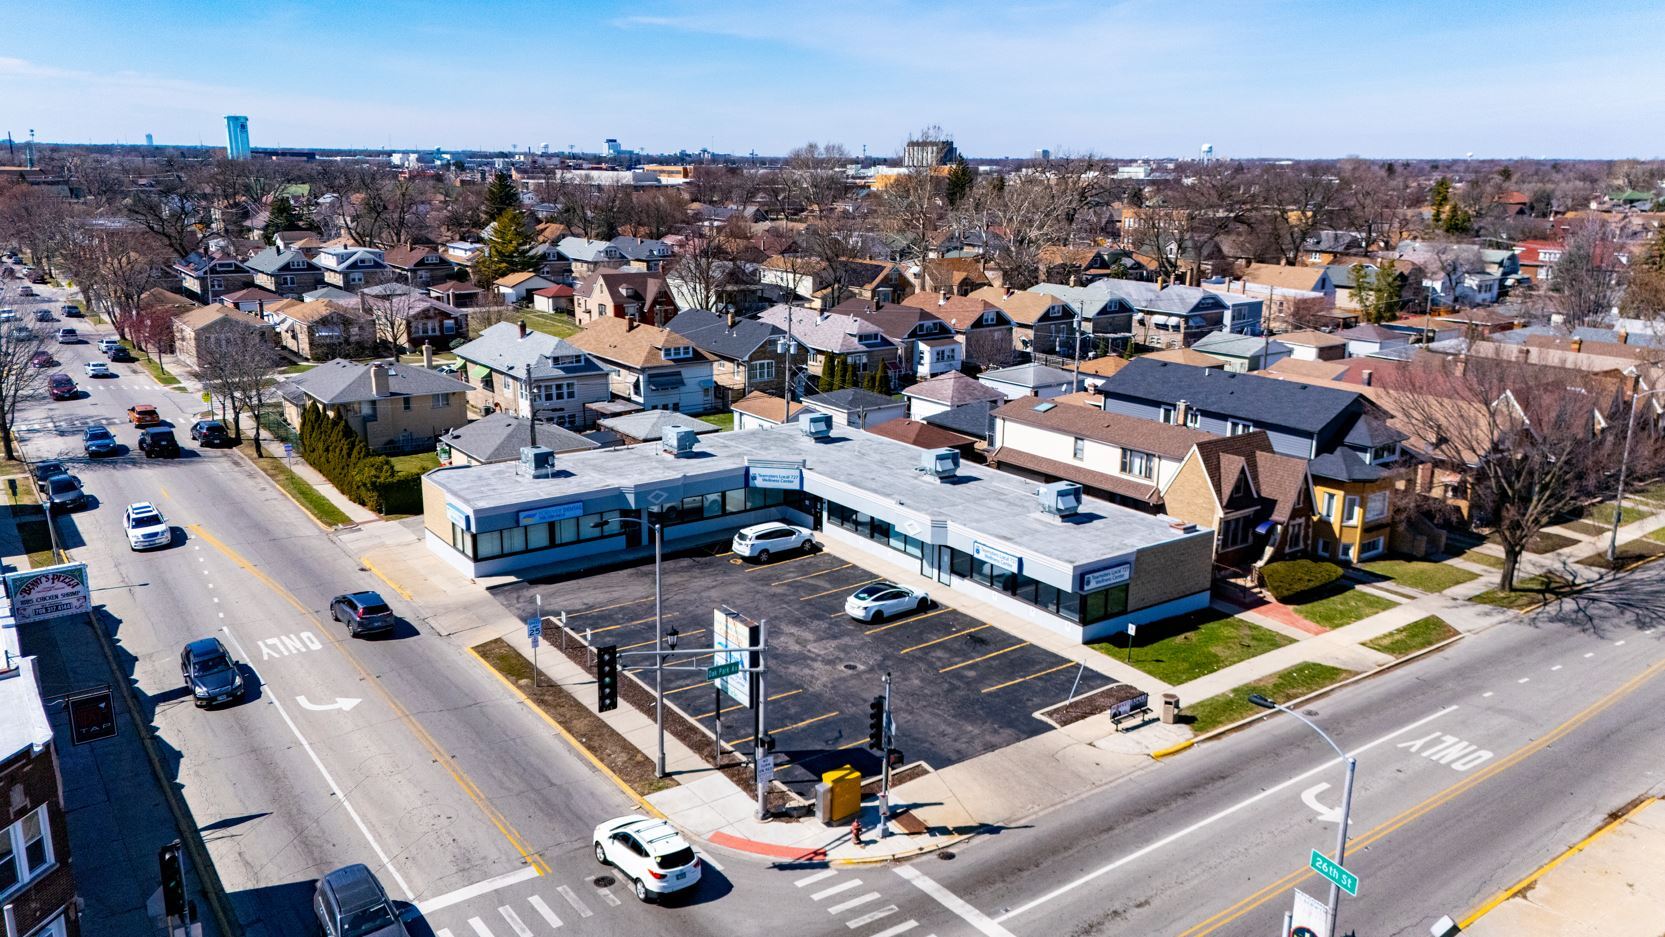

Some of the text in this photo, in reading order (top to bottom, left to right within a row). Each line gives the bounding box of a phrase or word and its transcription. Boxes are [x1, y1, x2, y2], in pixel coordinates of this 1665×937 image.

[20, 574, 50, 598] BENNY'S
[51, 573, 80, 589] PIZZA
[36, 594, 59, 603] CHICKEN
[529, 628, 541, 636] 25
[256, 631, 323, 661] ONLY
[719, 666, 730, 675] Park
[80, 722, 111, 734] TAP
[1396, 731, 1494, 771] ONLY
[1315, 857, 1353, 889] 26th St
